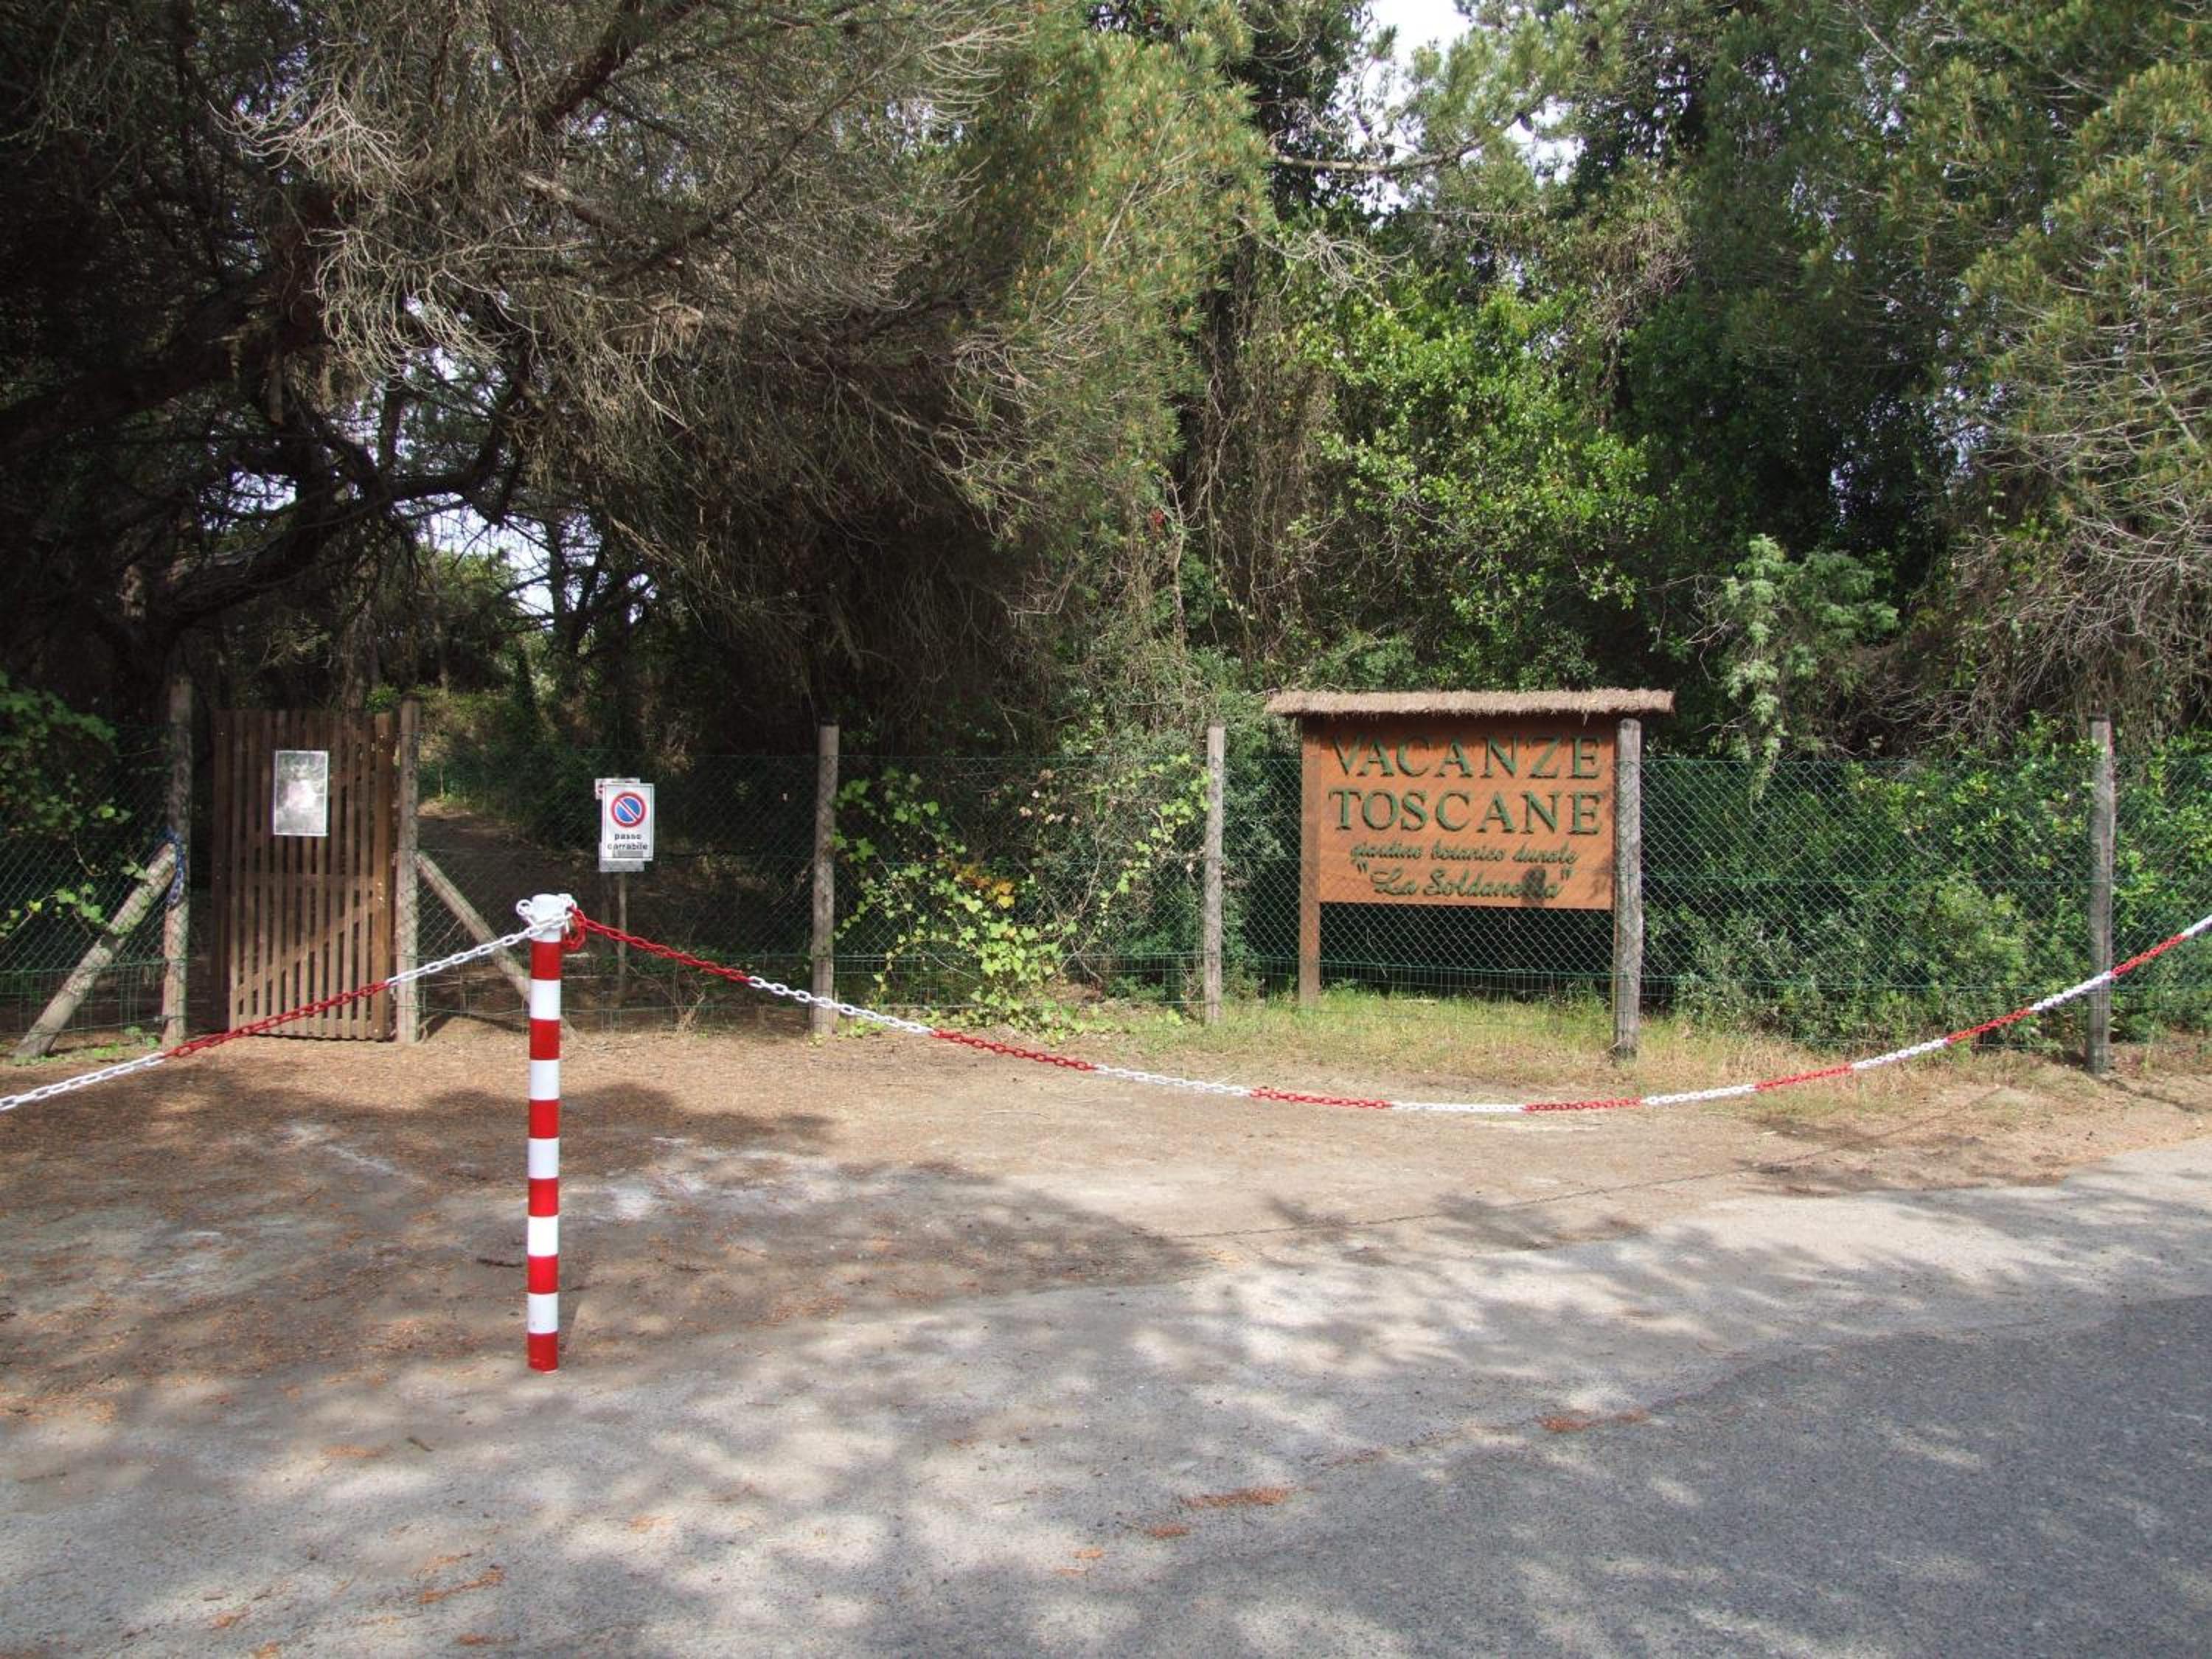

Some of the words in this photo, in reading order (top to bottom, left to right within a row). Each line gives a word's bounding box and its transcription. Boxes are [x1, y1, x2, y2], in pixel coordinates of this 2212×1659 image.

[1331, 733, 1600, 779] VACANZE
[1329, 789, 1602, 835] TOSCANE
[608, 842, 648, 850] carrabile
[1352, 841, 1422, 861] giardino
[1431, 839, 1503, 861] botanico
[1512, 841, 1579, 864] dunale
